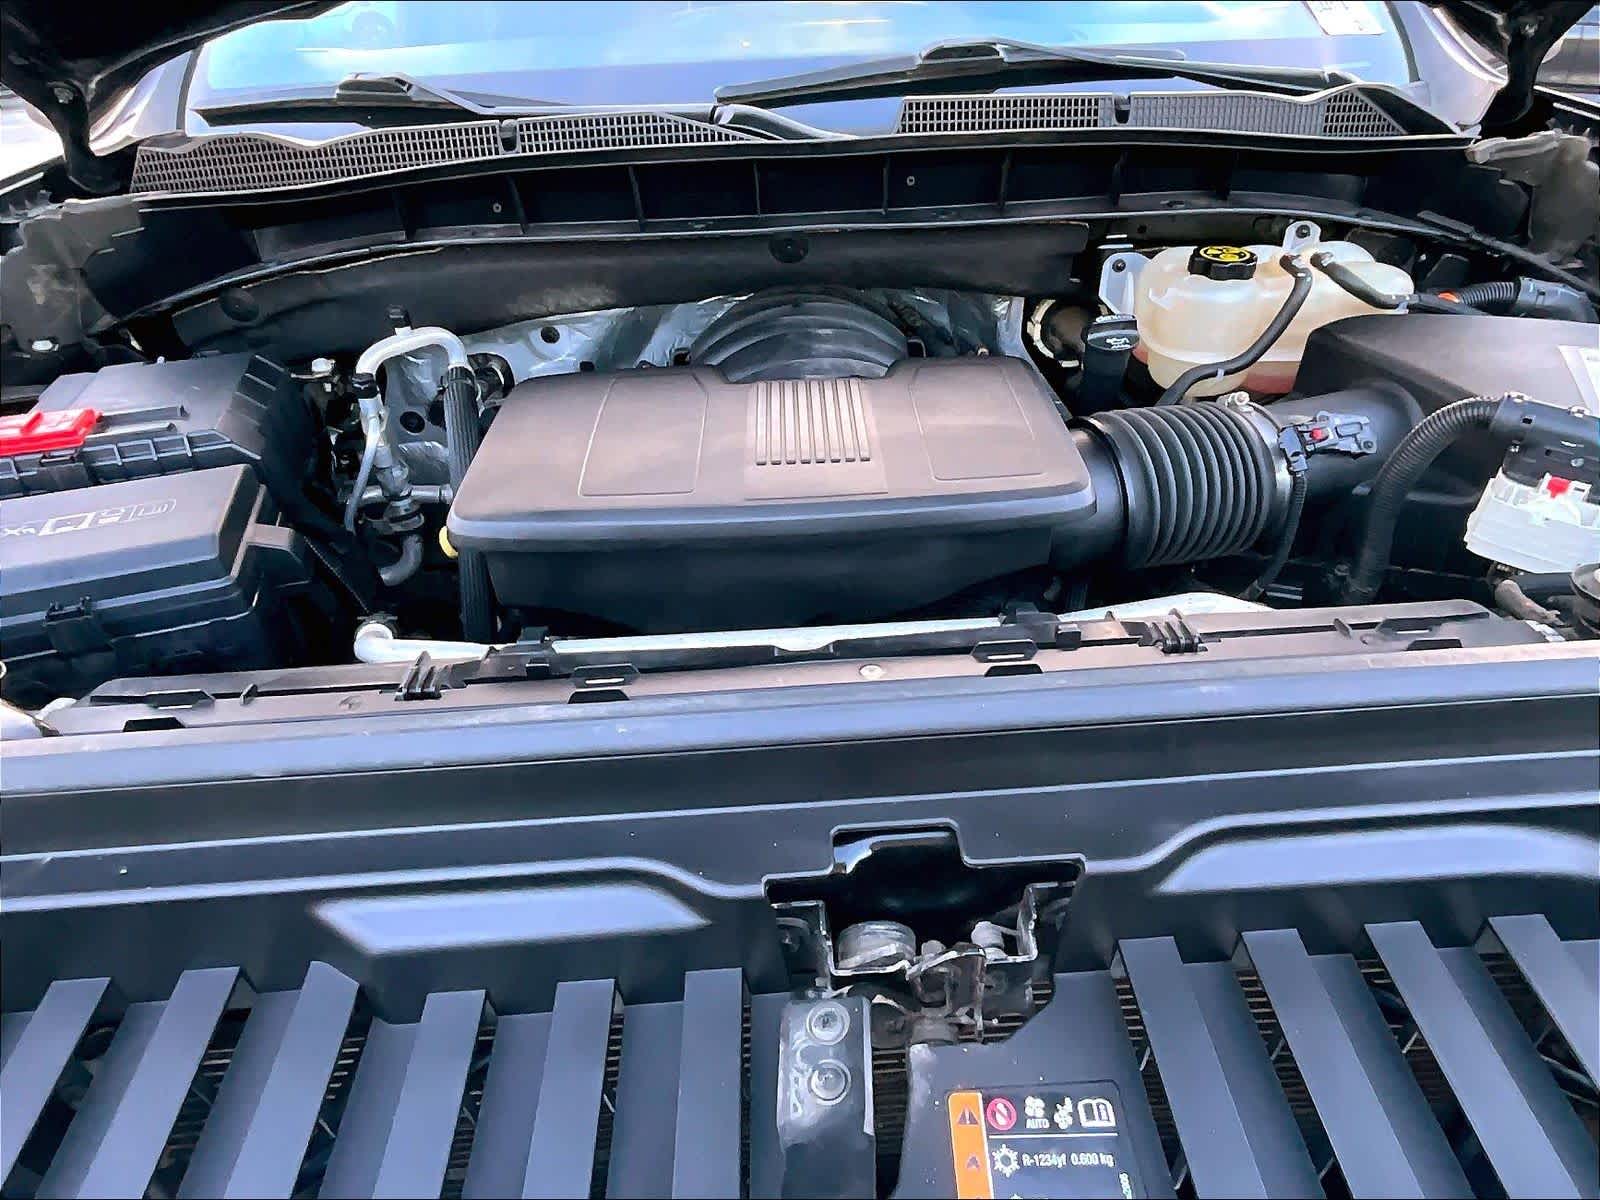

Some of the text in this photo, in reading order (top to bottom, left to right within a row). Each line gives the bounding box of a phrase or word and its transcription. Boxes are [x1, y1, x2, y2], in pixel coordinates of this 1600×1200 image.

[1025, 1118, 1050, 1129] AUTO
[1022, 1152, 1067, 1168] R-1234yf
[1100, 1152, 1115, 1168] kg
